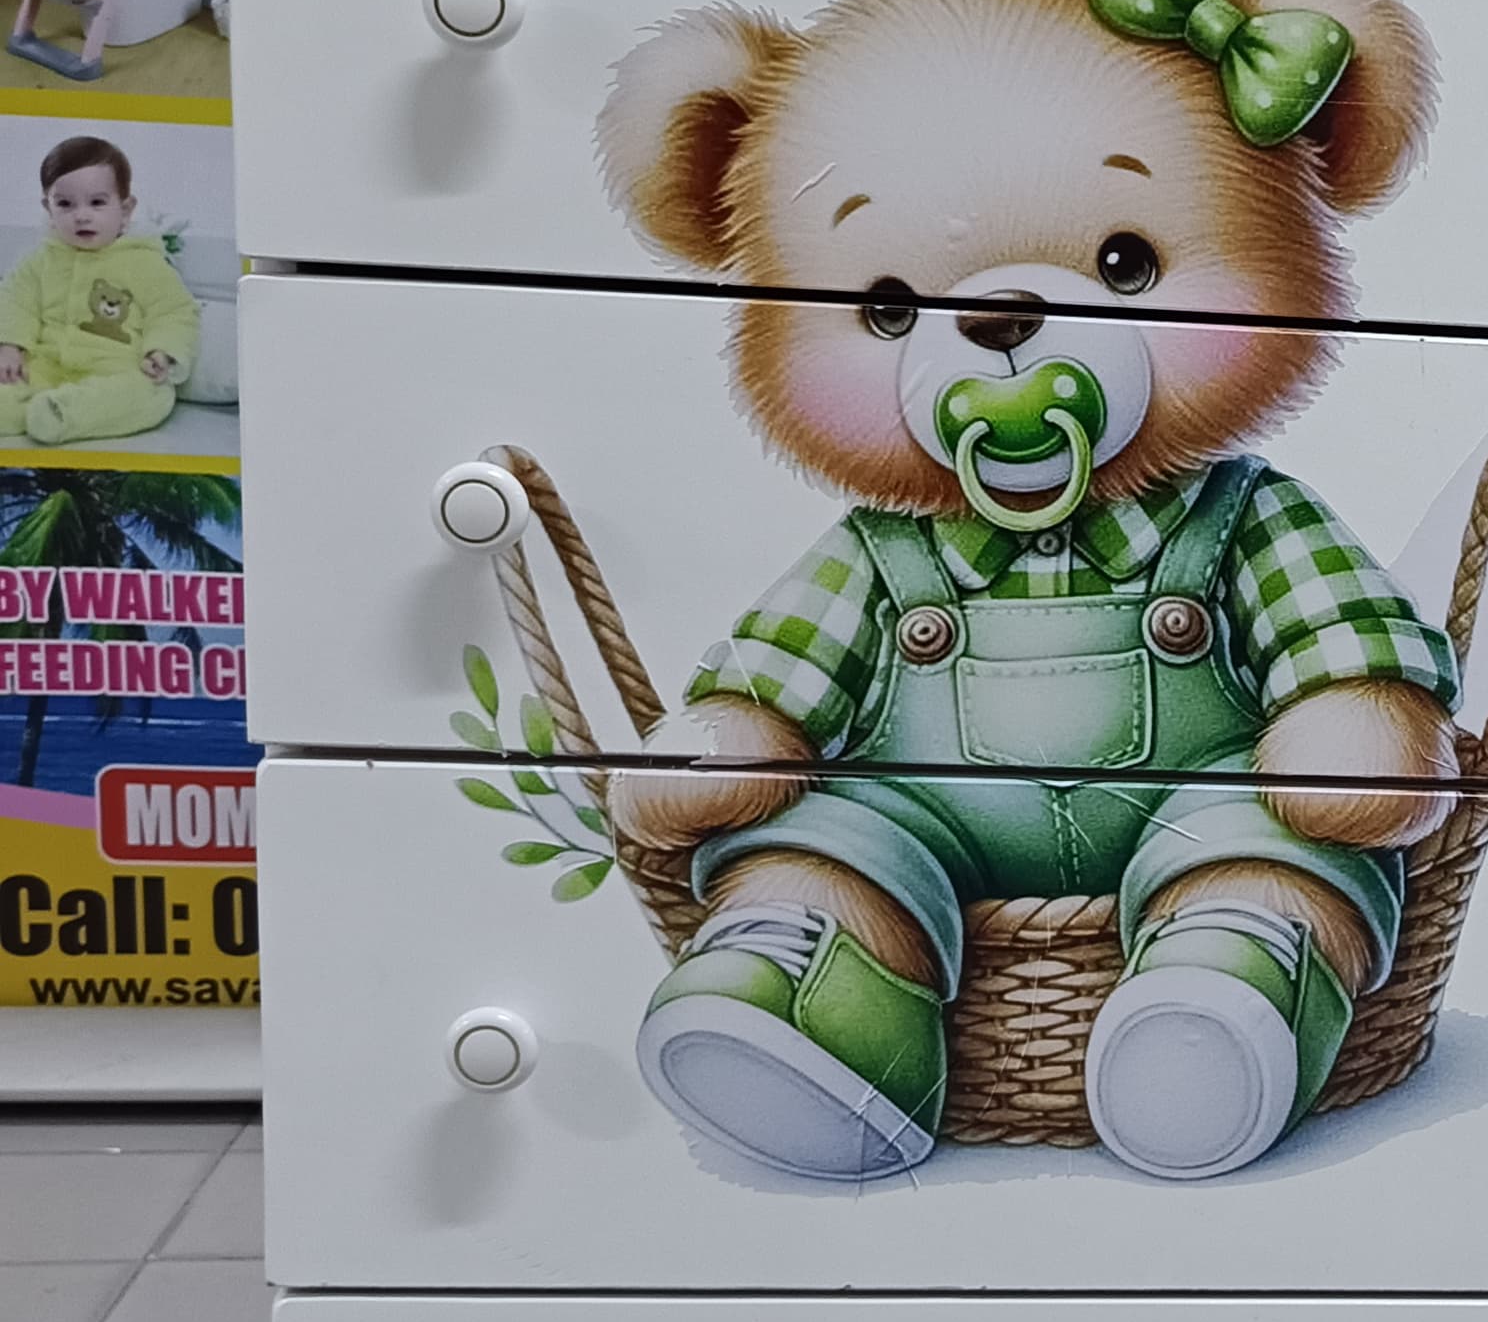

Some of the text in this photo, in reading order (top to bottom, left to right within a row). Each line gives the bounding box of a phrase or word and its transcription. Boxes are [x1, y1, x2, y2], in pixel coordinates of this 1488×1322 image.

[0, 568, 55, 621] BY
[0, 642, 246, 697] FEEDING C
[124, 782, 257, 849] MOM
[0, 873, 191, 957] Call:
